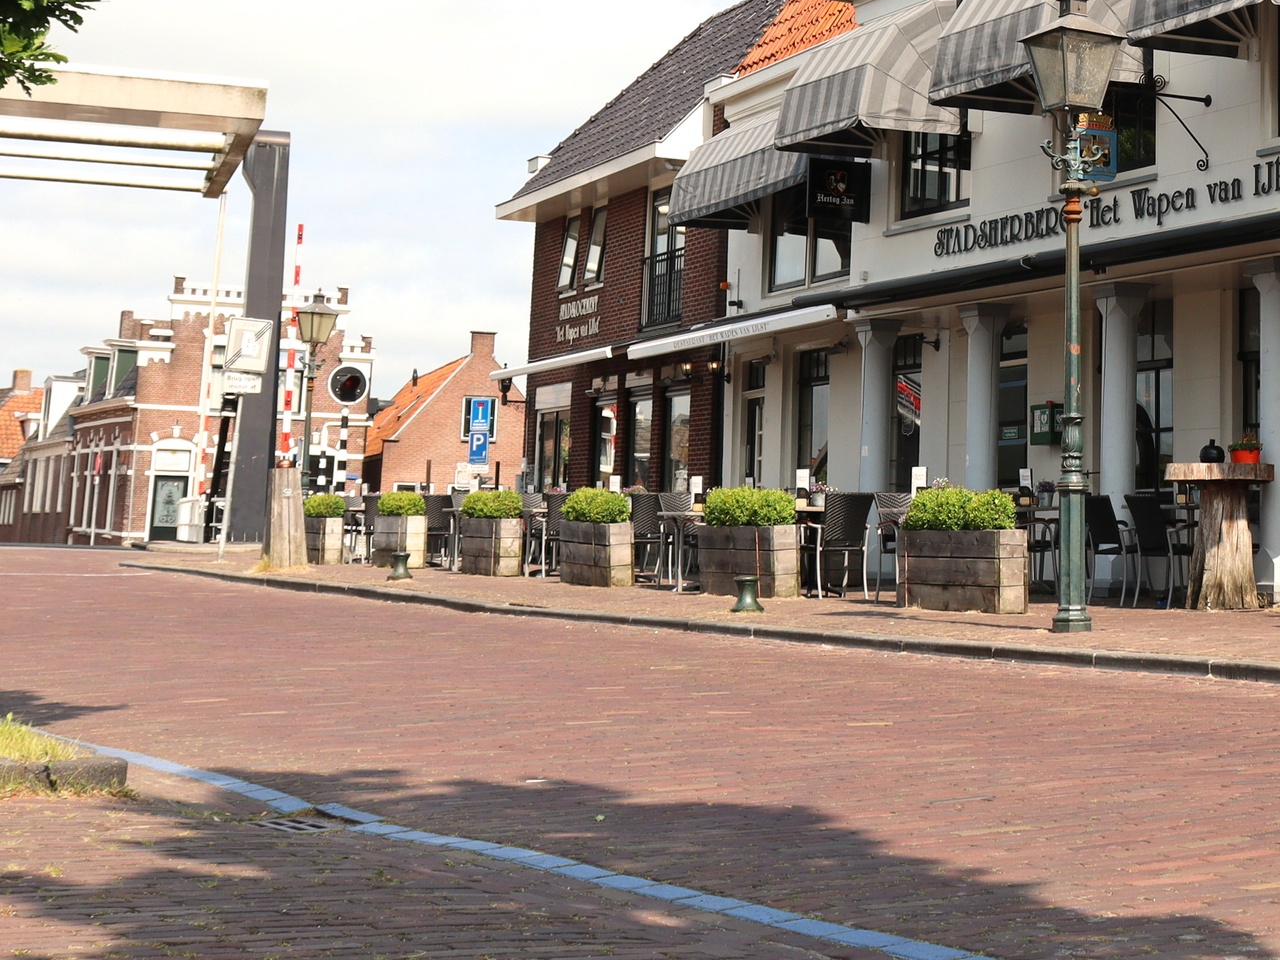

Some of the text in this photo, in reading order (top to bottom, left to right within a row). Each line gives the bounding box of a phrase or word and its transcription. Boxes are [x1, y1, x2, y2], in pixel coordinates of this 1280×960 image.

[816, 193, 855, 205] Hertog Jan
[1130, 187, 1196, 226] Wapen
[1206, 177, 1242, 204] van
[472, 434, 485, 451] P
